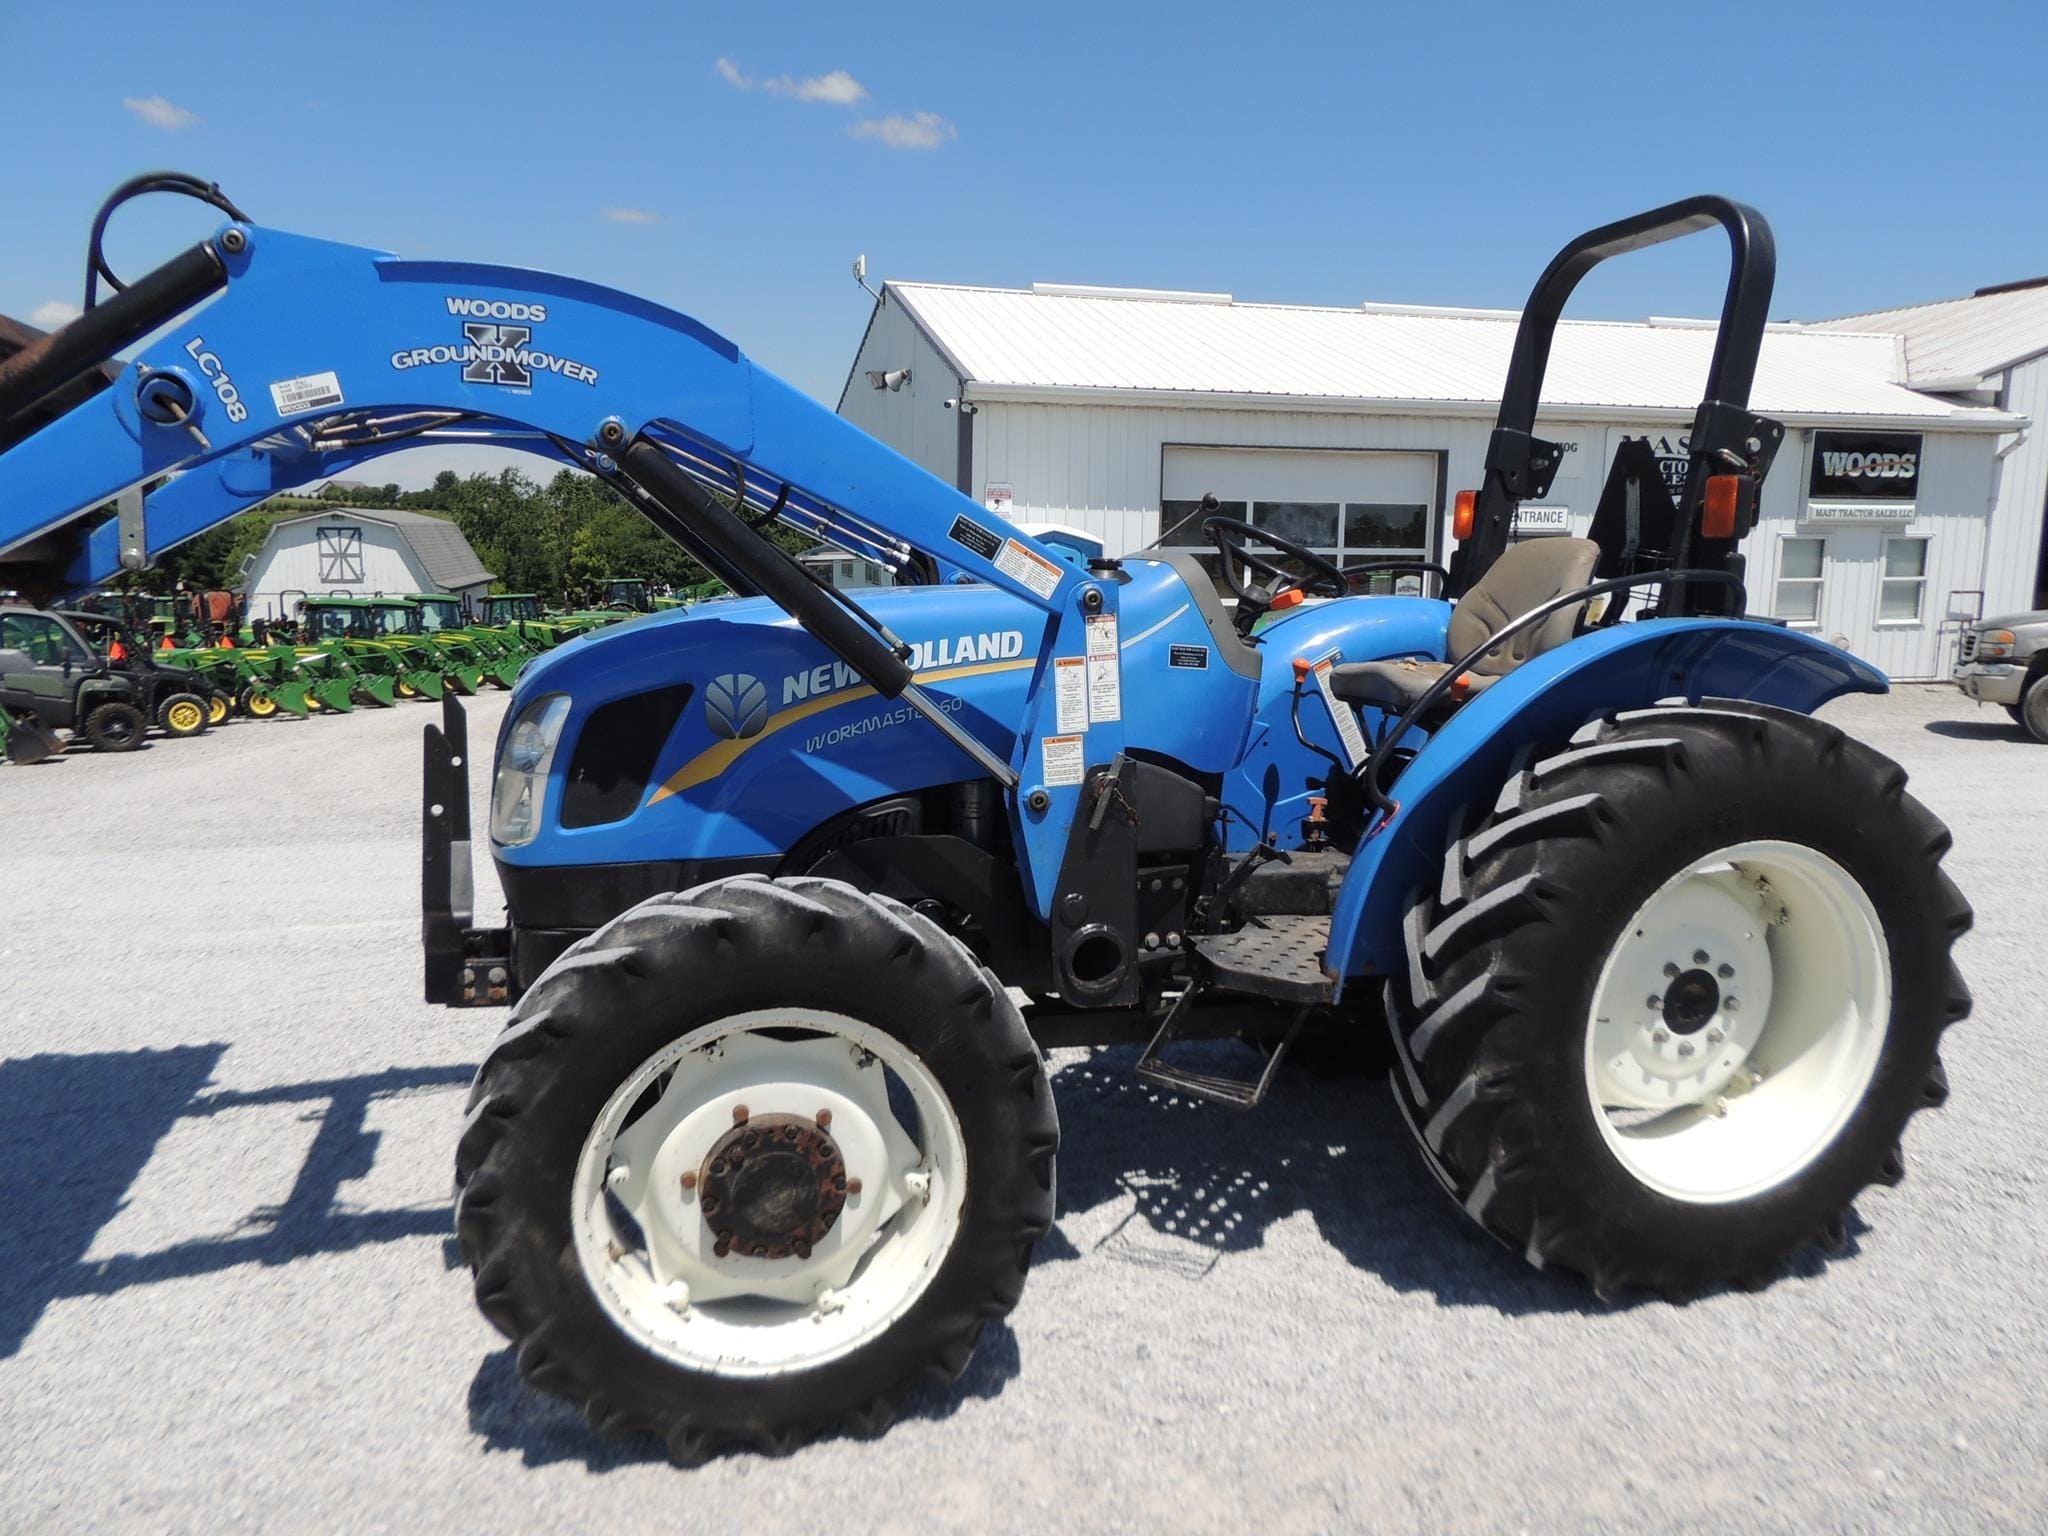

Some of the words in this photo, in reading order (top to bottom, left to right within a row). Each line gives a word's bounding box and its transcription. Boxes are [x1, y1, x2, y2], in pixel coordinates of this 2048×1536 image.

[446, 297, 546, 322] WOODS
[184, 336, 248, 423] LC108
[391, 345, 598, 386] GROUNDMOVER
[1822, 451, 1917, 479] WOODS
[1815, 509, 1837, 518] MAST
[1838, 509, 1873, 518] TRACTOR
[1875, 509, 1898, 518] SALES
[1899, 509, 1913, 518] LLC
[905, 630, 1023, 671] OLLAND
[806, 705, 924, 753] WORKMAST
